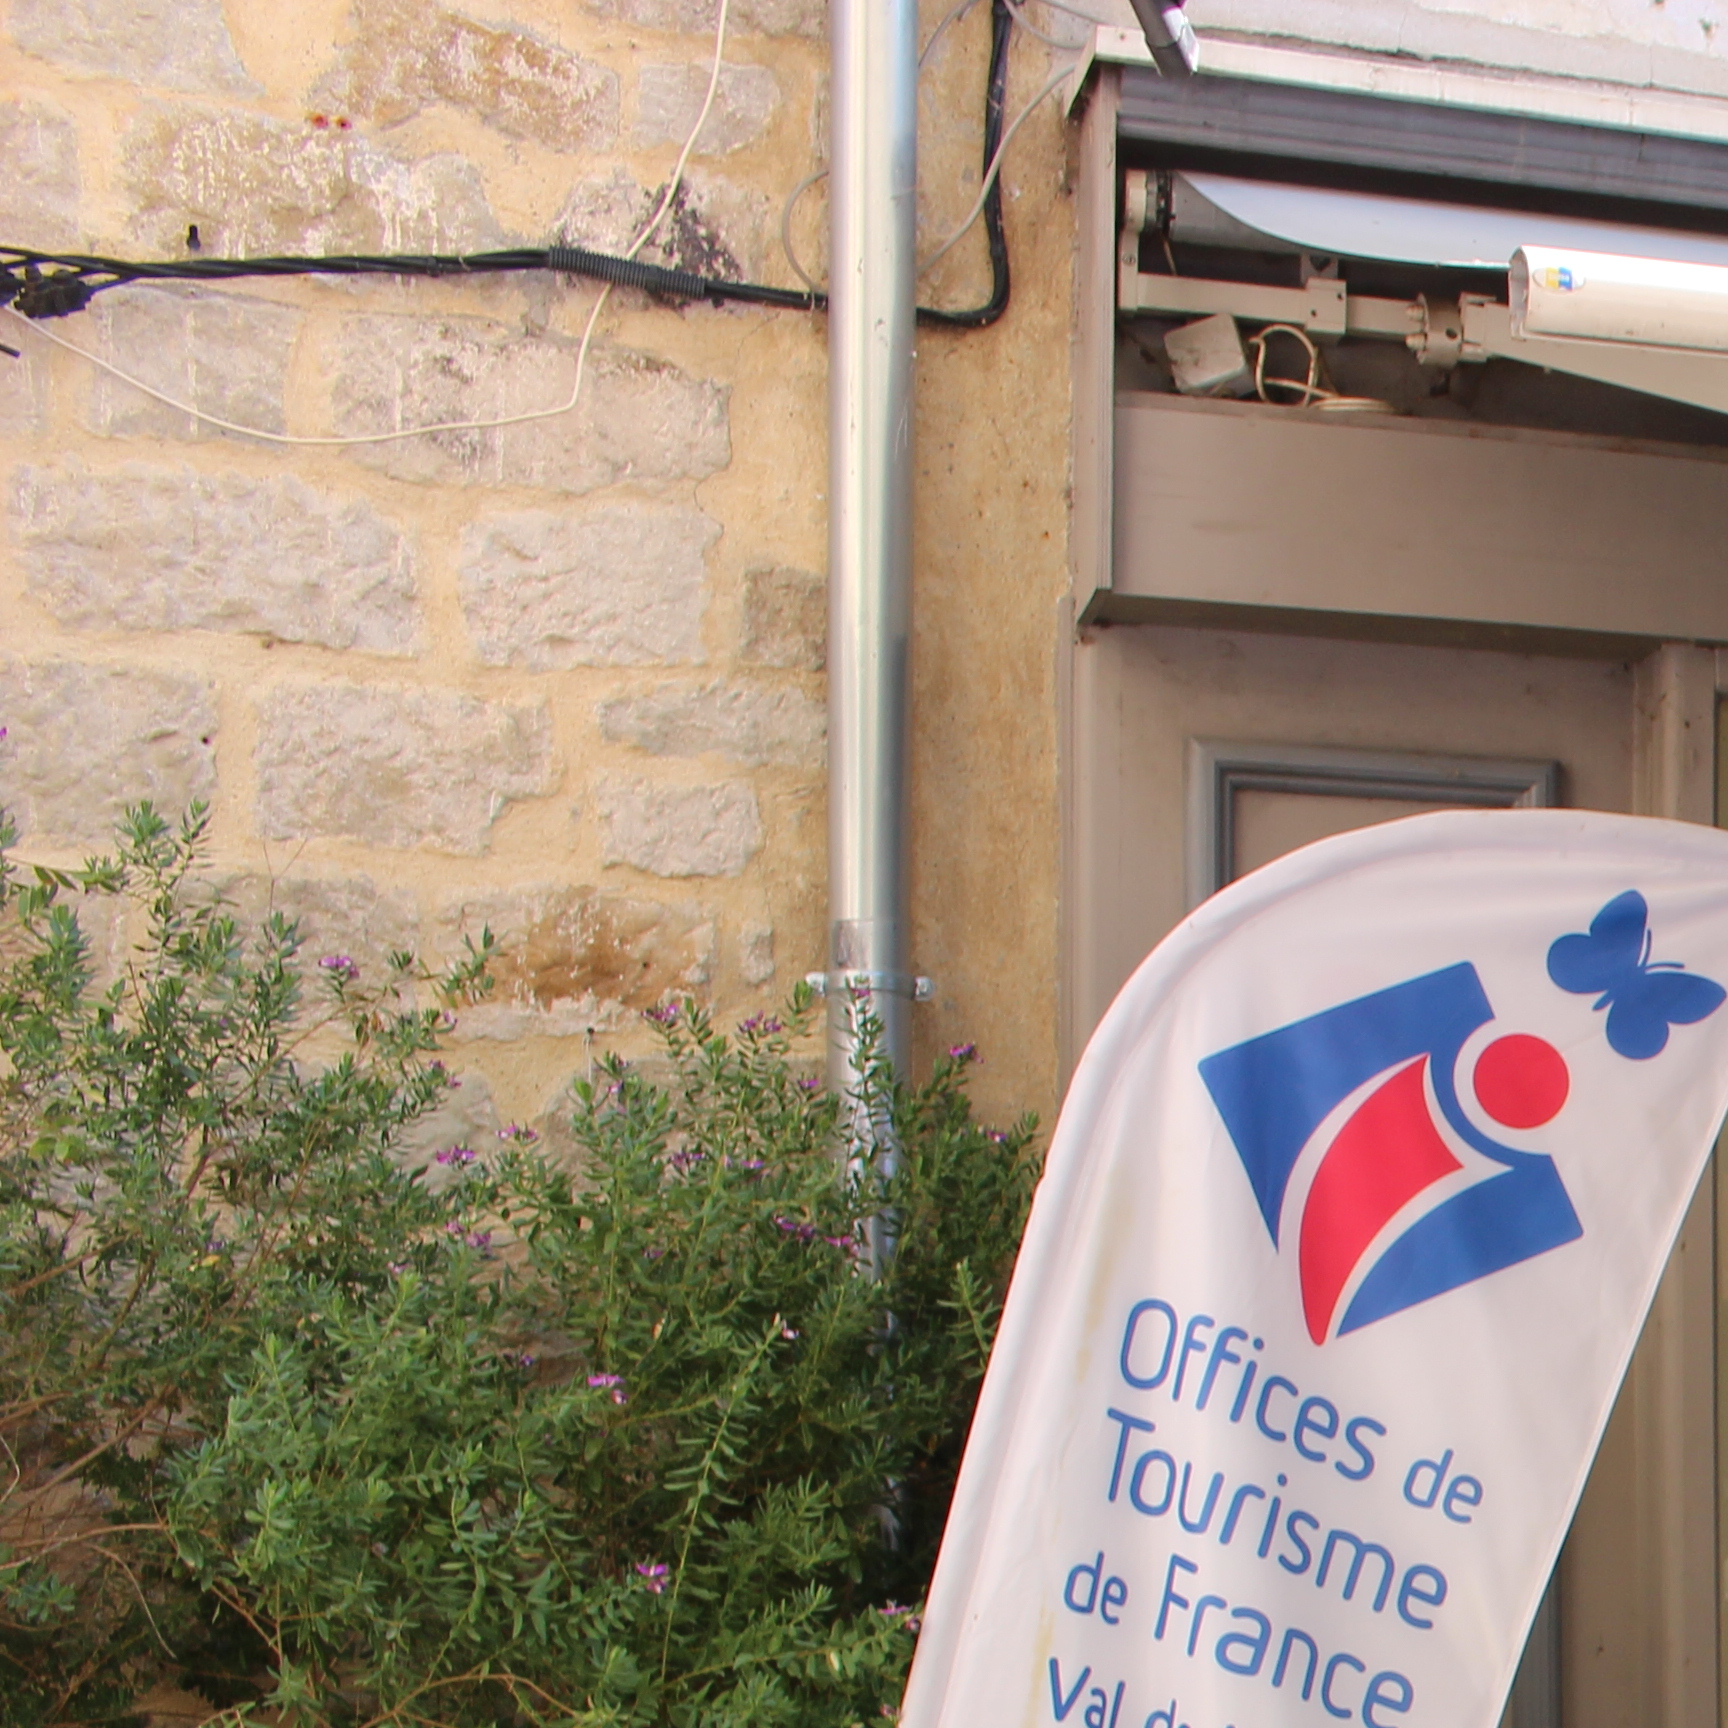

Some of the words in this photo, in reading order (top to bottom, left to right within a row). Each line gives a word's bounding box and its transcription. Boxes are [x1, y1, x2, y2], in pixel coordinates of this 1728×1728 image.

[1106, 1406, 1449, 1630] Tourisme
[1119, 1297, 1388, 1482] Offices
[1402, 1448, 1484, 1524] de
[1062, 1550, 1129, 1626] de
